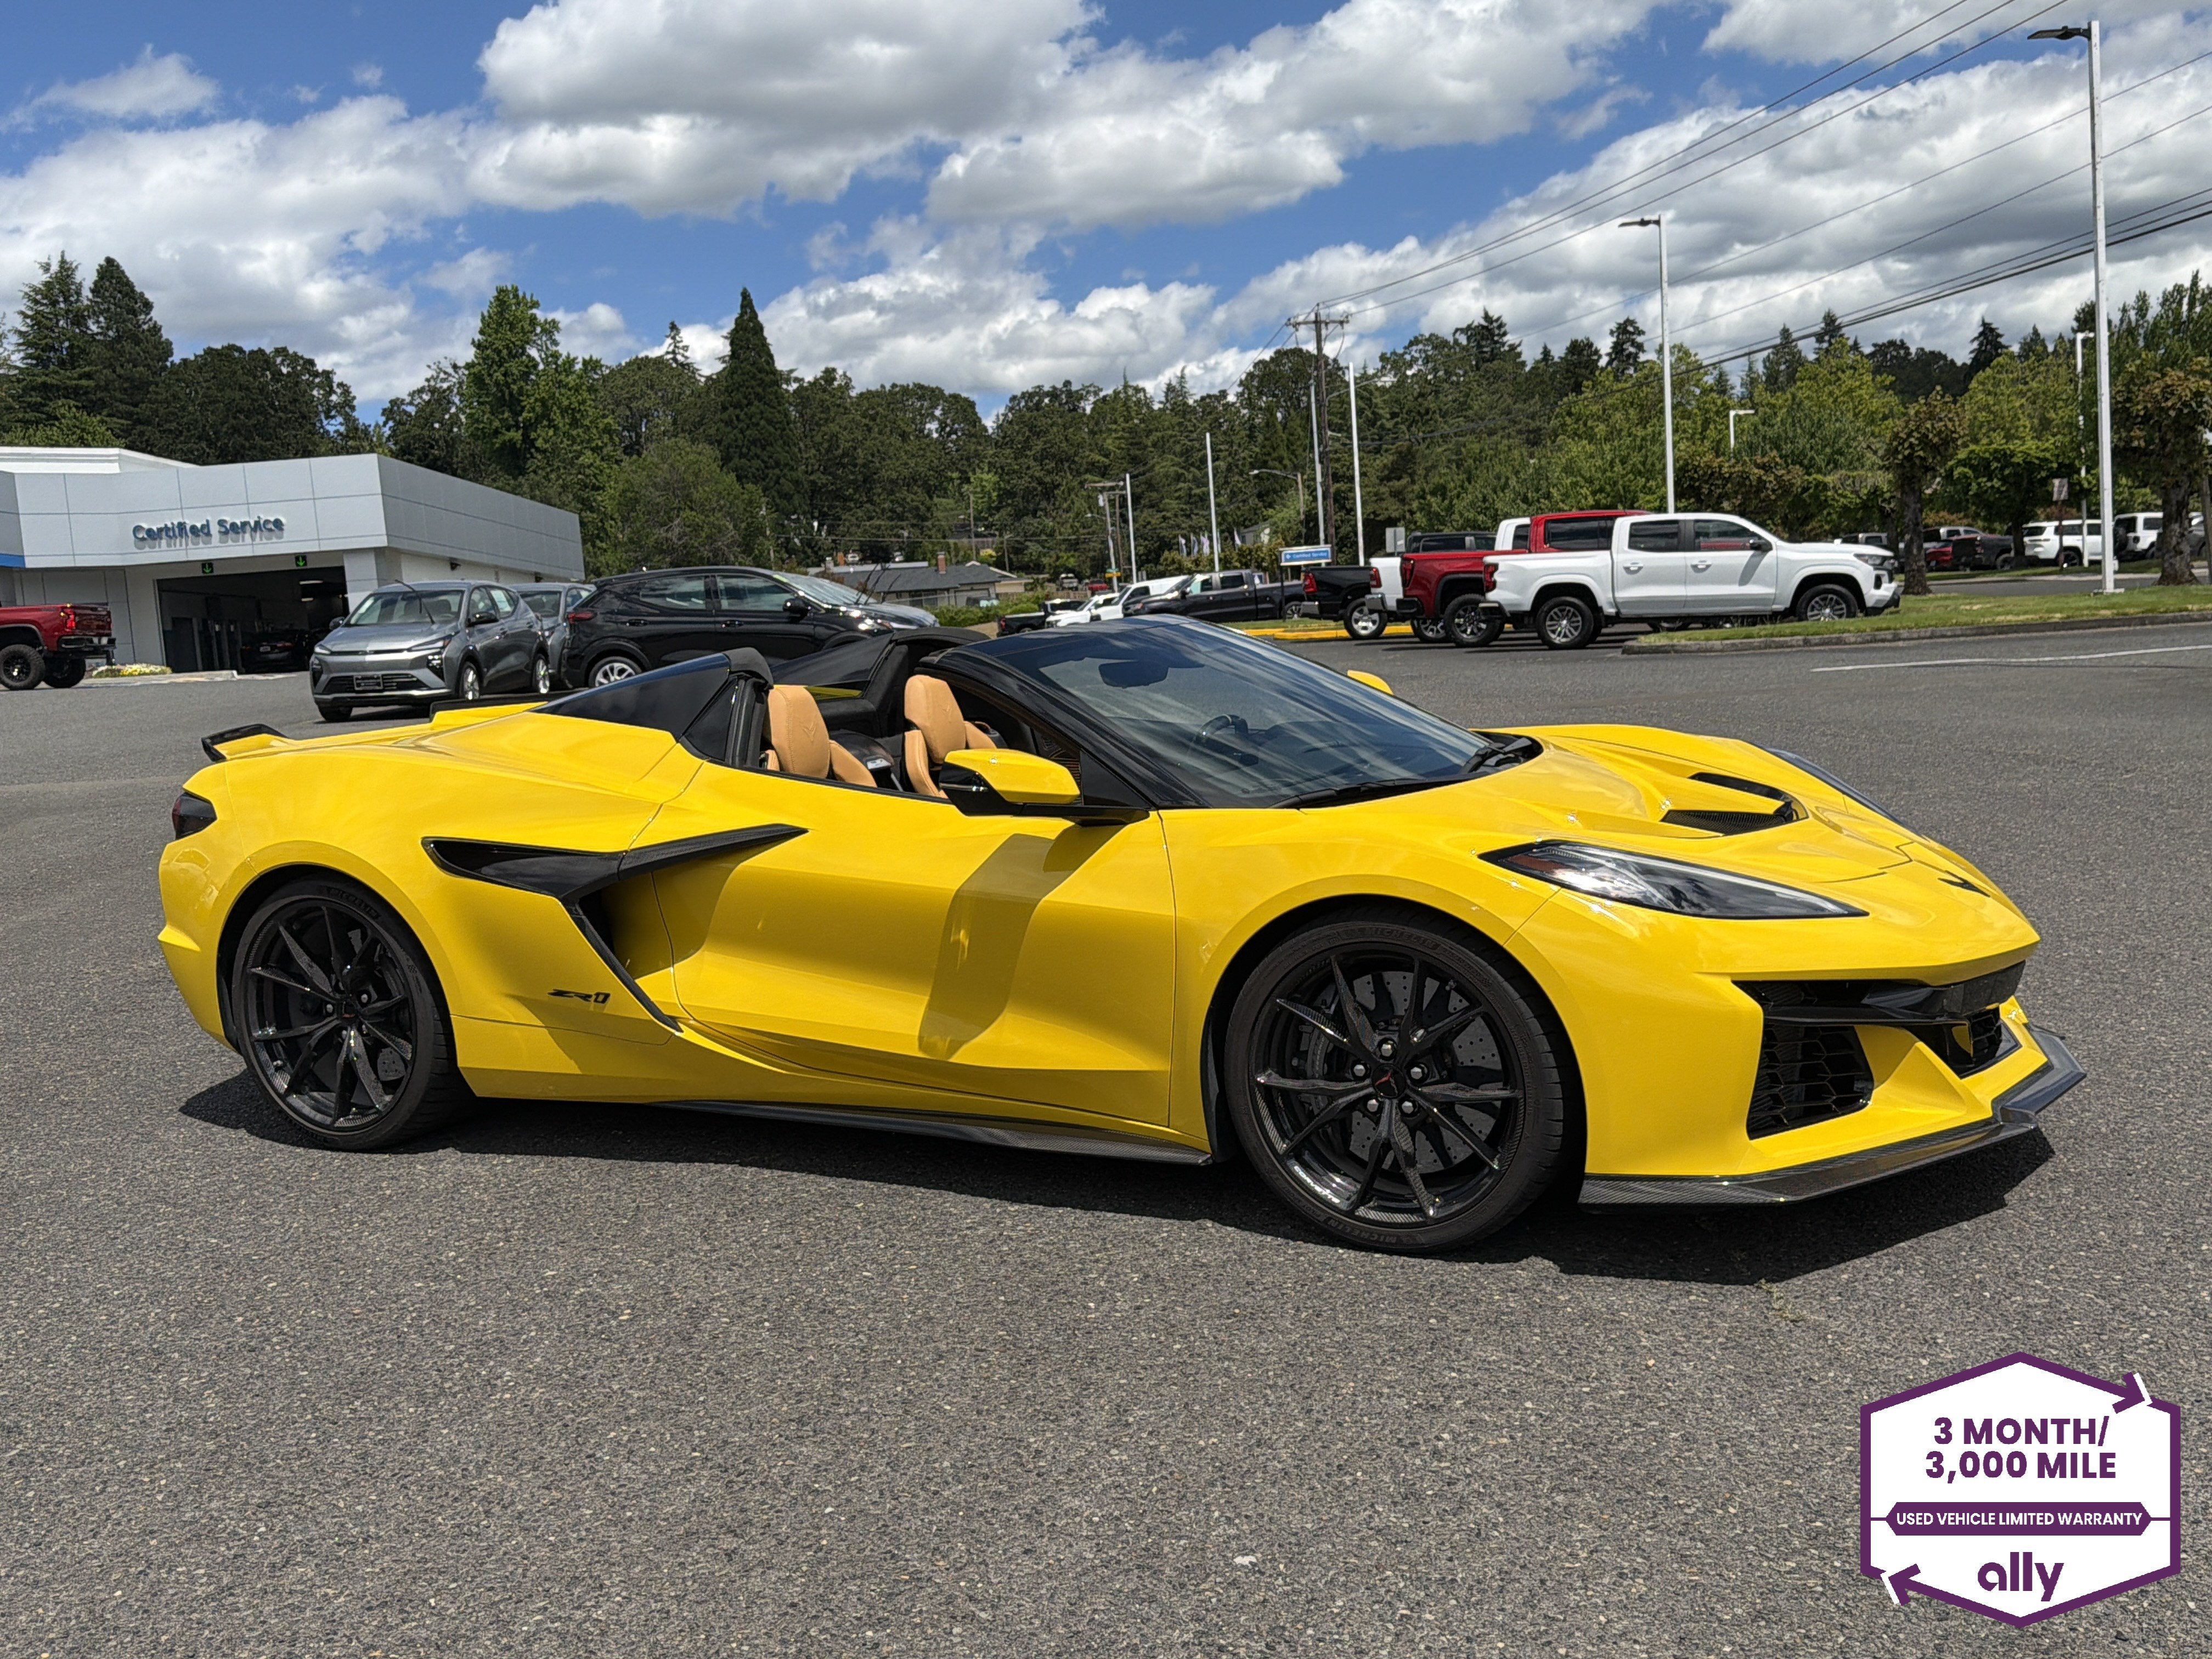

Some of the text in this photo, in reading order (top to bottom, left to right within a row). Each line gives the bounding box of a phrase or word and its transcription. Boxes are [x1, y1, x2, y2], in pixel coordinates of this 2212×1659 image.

[132, 516, 284, 541] Certified Service
[1327, 1218, 1397, 1244] MICHELIN
